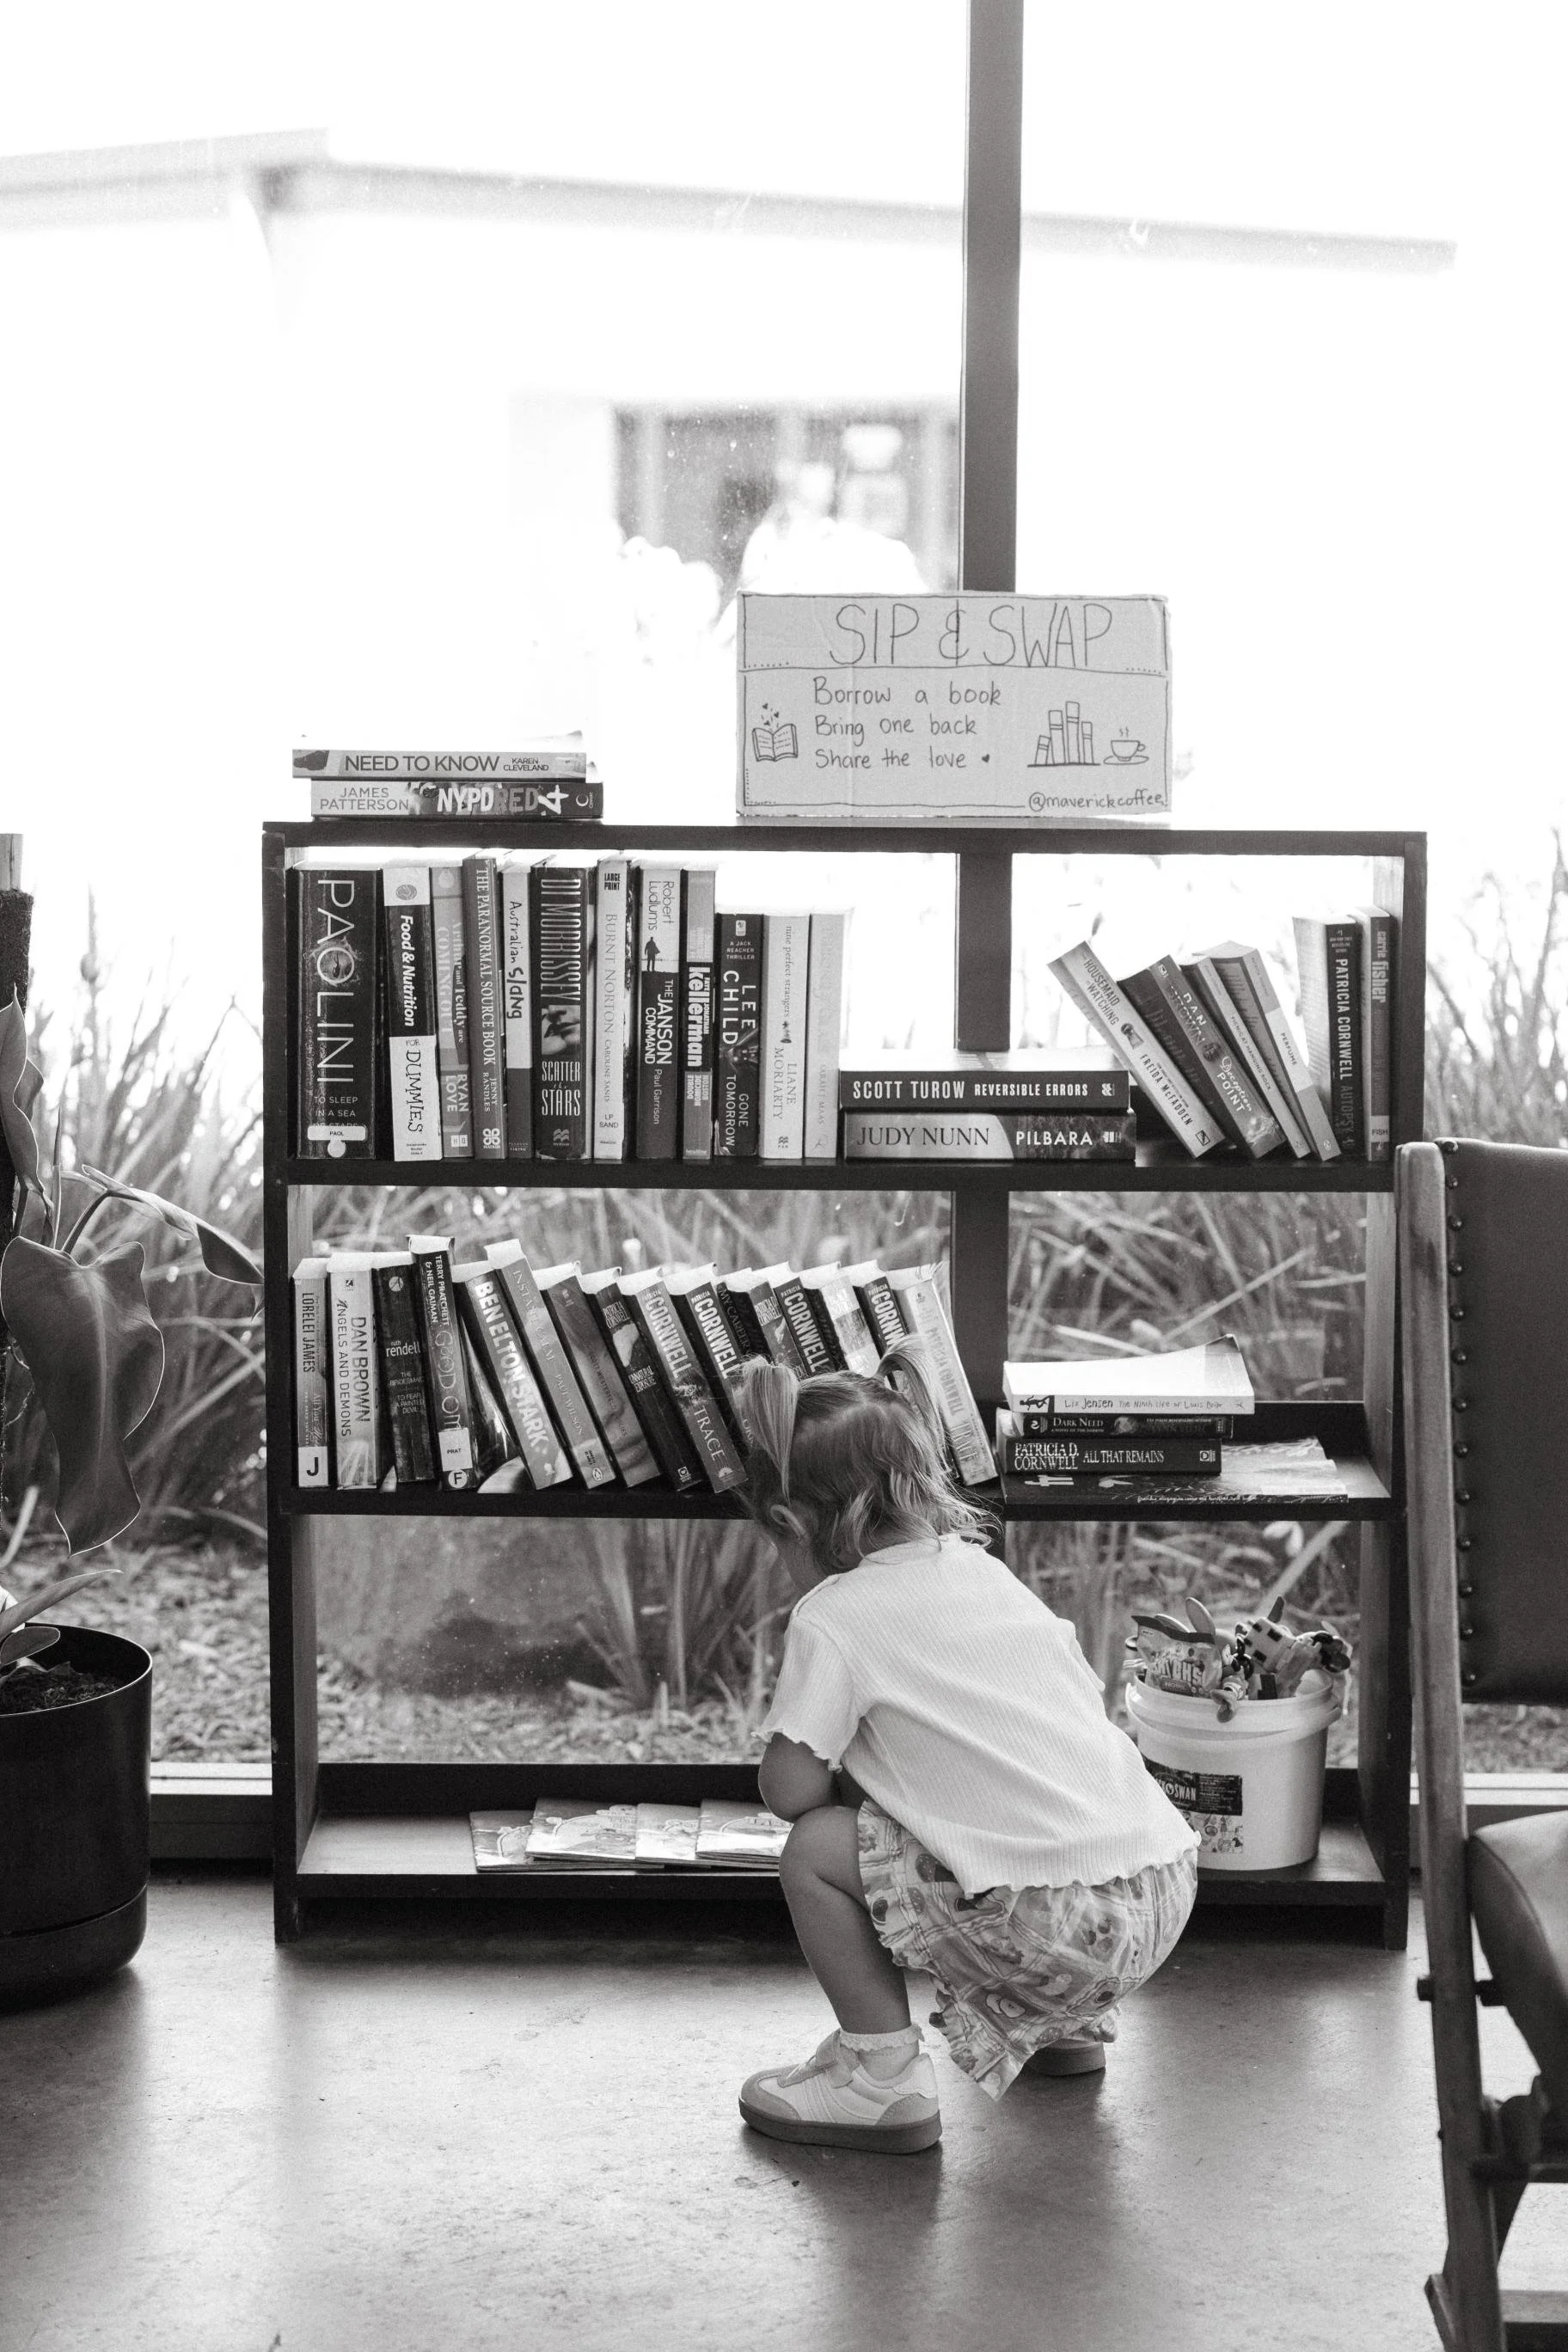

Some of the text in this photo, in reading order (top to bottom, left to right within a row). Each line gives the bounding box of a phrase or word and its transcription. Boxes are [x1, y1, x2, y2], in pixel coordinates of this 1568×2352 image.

[830, 603, 919, 665] SIP
[983, 603, 1112, 667] SWAP
[813, 676, 1001, 706] Borrow a book
[815, 713, 977, 746] Bring one back
[345, 756, 500, 771] NEED TO KNOW
[816, 747, 968, 770] Share the love
[320, 799, 409, 811] PATTERSON
[340, 787, 389, 798] JAMES
[437, 787, 494, 812] NYPD
[495, 787, 539, 812] RED
[538, 784, 569, 816] 4
[1028, 788, 1166, 812] @maverickcoffee
[604, 873, 621, 882] LARGE
[604, 882, 621, 891] PRINT
[662, 880, 675, 924] Robert
[510, 901, 523, 964] Australian
[540, 879, 581, 1001] DI MORRISSEY
[604, 914, 617, 964] BURNT
[1376, 931, 1387, 959] carrie
[316, 880, 355, 1082] PAOLINI
[400, 915, 418, 1026] Food & Nutrition
[437, 927, 454, 1032] COMING OUT
[476, 868, 496, 1066] THE PARANORMAL SOURCE BOOK
[783, 946, 794, 977] perfect
[1371, 961, 1389, 1003] fisher
[603, 970, 616, 1033] NORTON
[664, 979, 674, 998] THE
[1083, 959, 1121, 1008] HOUSEMAID
[1087, 983, 1119, 1026] WATCHING
[1335, 959, 1350, 1013] PATRICIA
[453, 986, 467, 1028] Teddy
[687, 966, 710, 1067] kellerman
[722, 970, 739, 1044] CHILD
[741, 985, 756, 1029] LEE
[1167, 988, 1206, 1046] BROWN
[1183, 991, 1208, 1026] DAN
[645, 1007, 657, 1065] COMMAND
[656, 993, 673, 1065] JANSON
[1230, 1015, 1245, 1039] PICNIC
[1246, 1044, 1264, 1075] HANGING
[1280, 1032, 1298, 1066] PERFUME
[1337, 1016, 1353, 1081] CORNWELL
[405, 1050, 424, 1132] DUMMIES
[482, 1072, 491, 1112] RANDLES
[489, 1078, 498, 1106] JENNY
[542, 1061, 580, 1081] SCATTER
[773, 1047, 785, 1120] MORIARTY
[787, 1063, 798, 1106] LIANE
[853, 1080, 1088, 1099] SCOTT TUROW REVERSIBLE ERRORS
[1140, 1054, 1164, 1085] FREIDA
[1161, 1082, 1194, 1126] McFADDEN
[1216, 1072, 1246, 1112] POINT
[1222, 1056, 1253, 1112] Deception
[445, 1075, 457, 1112] LOVE
[457, 1074, 469, 1112] RYAN
[542, 1089, 581, 1117] STARS
[653, 1069, 663, 1124] Paul Garrison
[725, 1075, 737, 1146] TOMORROW
[738, 1093, 750, 1127] GONE
[1340, 1085, 1355, 1133] AUTOPSY
[857, 1127, 1093, 1146] JUDY NUNN PILBARA
[426, 1269, 438, 1324] NEIL GAIMAN
[435, 1255, 450, 1326] TERRY PRATCHETT
[690, 1290, 711, 1304] PATRICIA
[781, 1285, 801, 1298] PATRICIA
[867, 1283, 889, 1296] PATRICIA
[302, 1292, 315, 1373] LORELEI JAMES
[385, 1341, 421, 1357] rendell
[513, 1270, 584, 1436] INSTANT CALM PAUL WILSON
[646, 1296, 692, 1380] CORNWELL
[695, 1297, 740, 1380] CORNWELL
[784, 1292, 830, 1373] CORNWELL
[335, 1299, 352, 1437] ANGELS AND DEMONS
[351, 1316, 371, 1423] DAN BROWN
[475, 1280, 550, 1448] BEN ELTON STARK
[1081, 1398, 1114, 1410] Jensen
[694, 1405, 726, 1461] TRACE
[1014, 1442, 1080, 1456] PATRICIA D.
[306, 1456, 319, 1477] J
[1014, 1455, 1078, 1471] CORNWELL
[1083, 1449, 1165, 1463] ALL THAT REMAINS
[453, 1472, 462, 1485] F
[1174, 1783, 1197, 1801] SWAN
